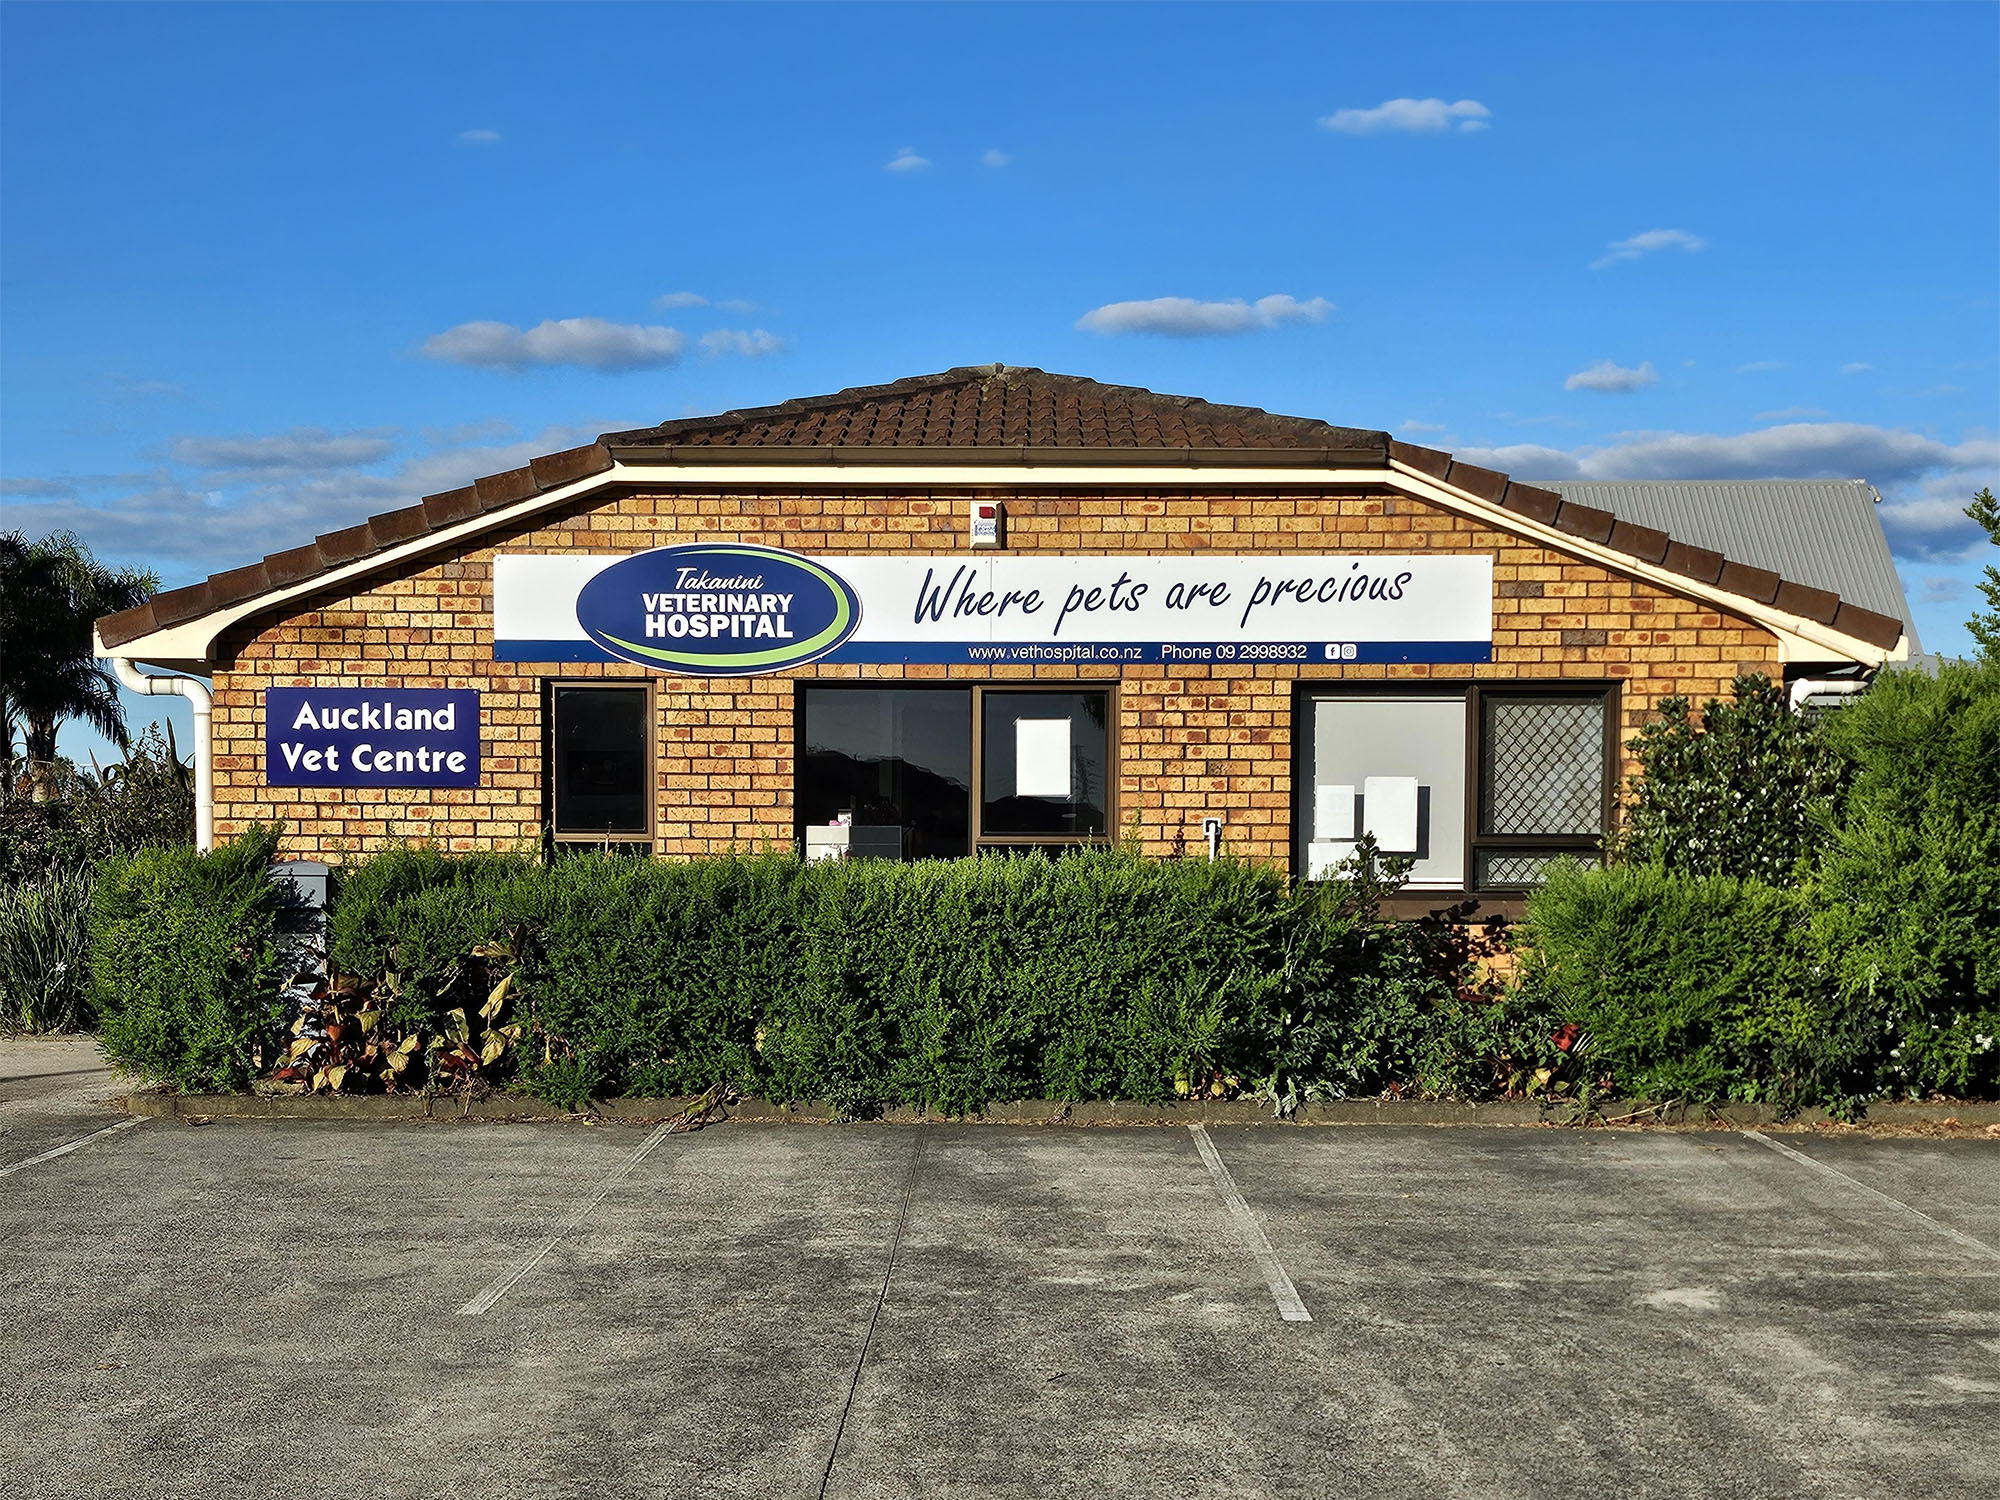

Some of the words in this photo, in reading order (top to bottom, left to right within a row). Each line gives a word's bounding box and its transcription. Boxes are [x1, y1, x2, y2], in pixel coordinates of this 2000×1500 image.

[675, 567, 764, 590] Takanini
[641, 593, 794, 613] VETERINARY
[914, 564, 1044, 625] Where
[1053, 571, 1149, 637] pets
[1165, 581, 1232, 610] are
[1240, 562, 1413, 629] precious
[645, 614, 794, 638] HOSPITAL
[968, 644, 1142, 662] www.vethospital.co.nz
[1161, 644, 1212, 659] Phone
[1215, 644, 1236, 659] 09
[1239, 644, 1307, 659] 2998932
[291, 700, 455, 731] Auckland
[280, 742, 340, 772] Vet
[351, 743, 467, 773] Centre
